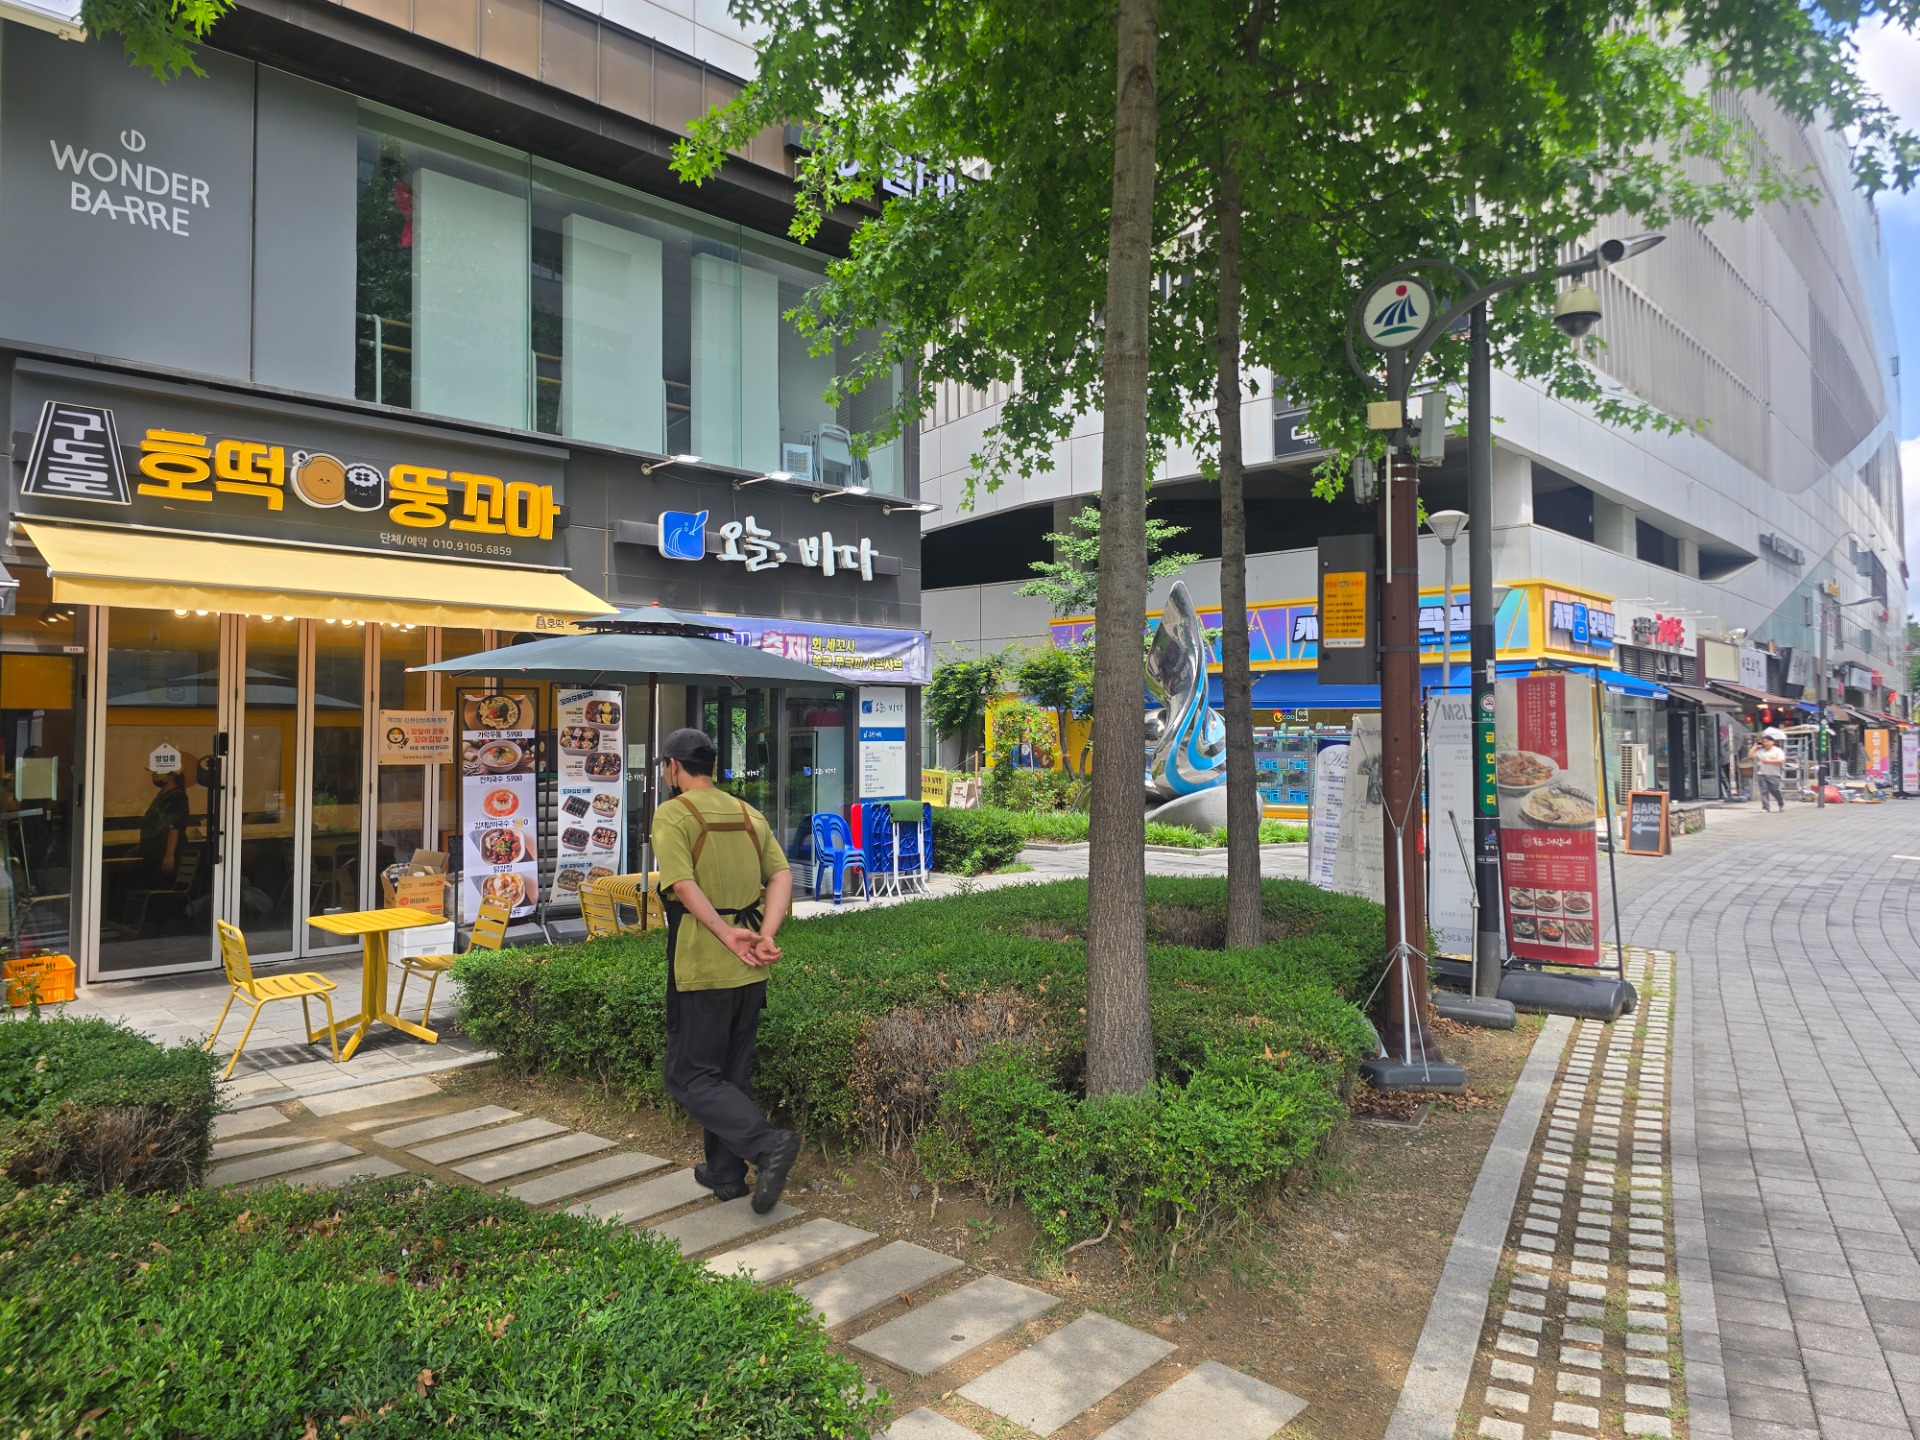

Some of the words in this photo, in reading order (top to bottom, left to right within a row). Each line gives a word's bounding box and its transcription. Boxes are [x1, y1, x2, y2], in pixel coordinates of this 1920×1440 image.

[50, 140, 210, 208] WONDER
[71, 181, 189, 236] BARRE
[137, 429, 285, 511] 호떡
[389, 464, 560, 541] 뚱꼬마
[380, 532, 427, 549] 단체/예약
[433, 538, 512, 556] 010.9105.6859
[798, 531, 879, 582] 바다
[865, 657, 903, 671] 샤브샤브
